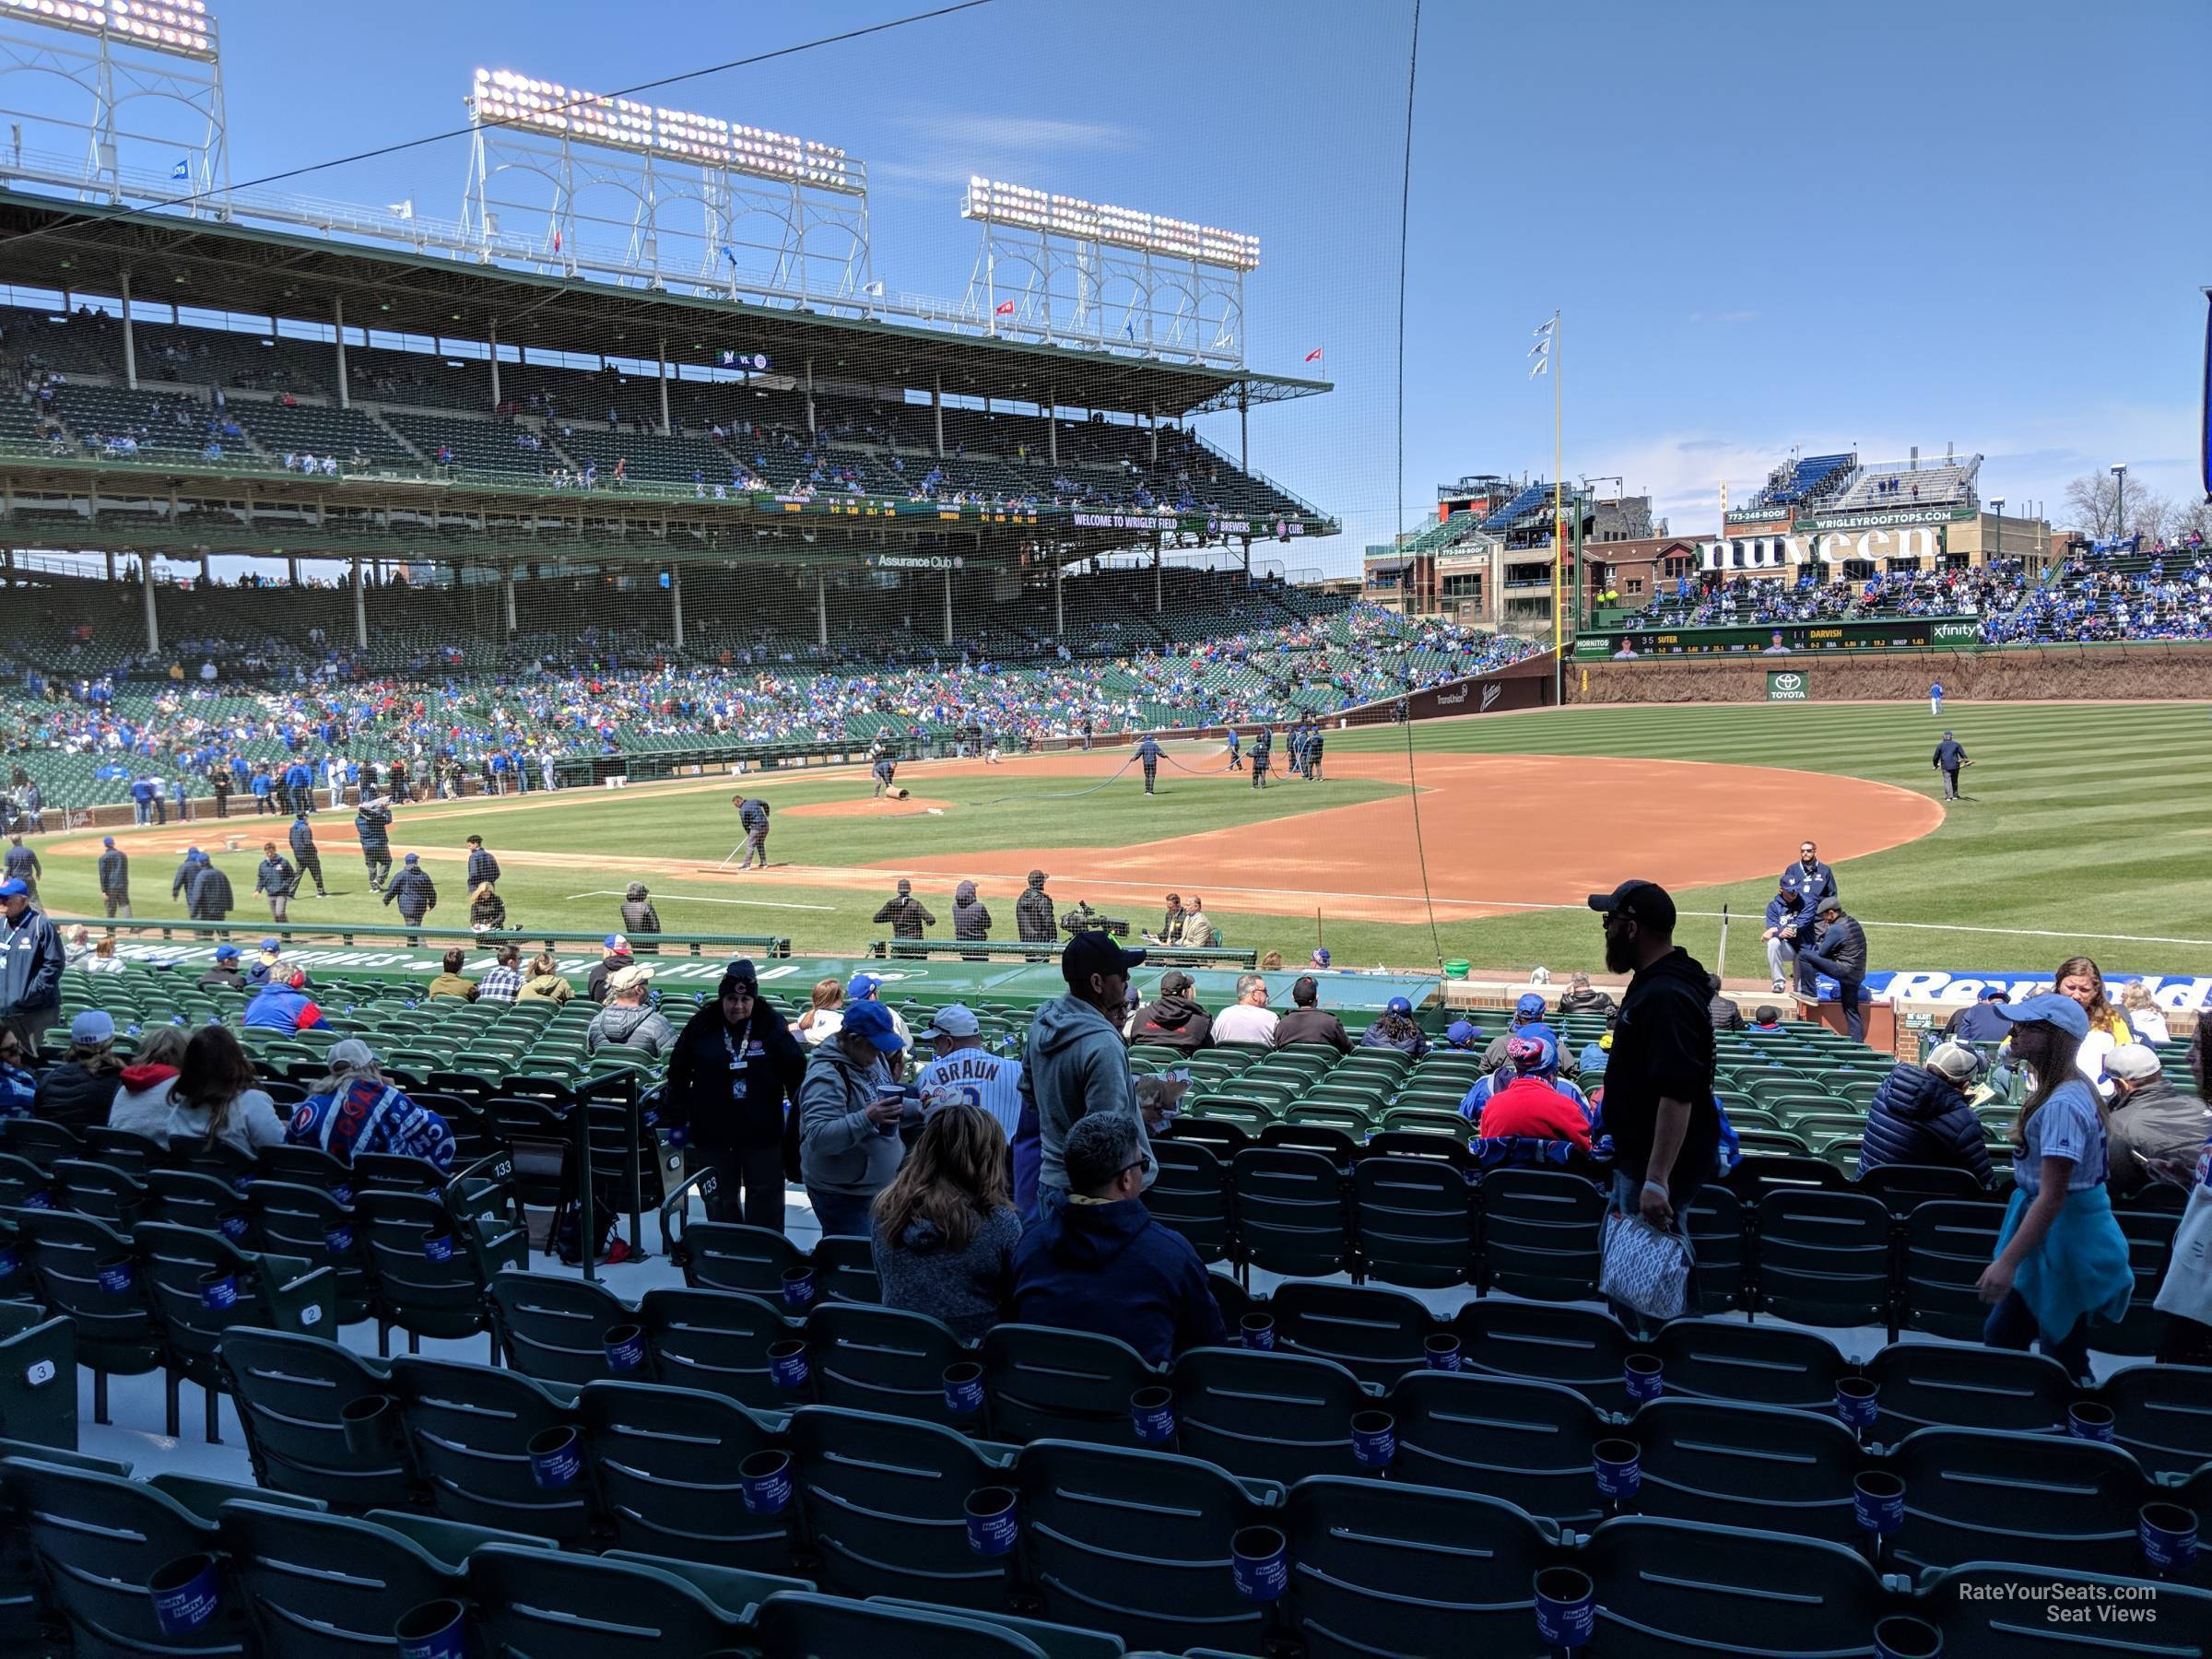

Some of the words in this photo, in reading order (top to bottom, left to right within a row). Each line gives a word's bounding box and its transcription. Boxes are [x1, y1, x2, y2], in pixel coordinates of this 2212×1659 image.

[785, 503, 801, 512] SUTER
[1074, 513, 1112, 526] WELCOME
[1113, 515, 1124, 526] TO
[1125, 516, 1156, 528] WRIGLEY
[1159, 517, 1178, 530] FIELD
[1728, 510, 1786, 521] 773-248-ROOF
[1816, 512, 1951, 529] WRIGLEYROOFTOPS.COM
[1220, 521, 1250, 533] BREWERS
[1288, 522, 1305, 535] CUBS
[1699, 525, 1936, 571] nuveen
[878, 554, 930, 567] Assurance
[931, 556, 952, 569] Club
[1810, 629, 1842, 638] DARVISH
[1935, 624, 1976, 638] xfinity
[1577, 639, 1610, 647] HORNITOS
[1657, 636, 1677, 644] SUTER
[1437, 694, 1464, 705] TransUnion
[936, 1059, 1000, 1085] BRAUN
[494, 1160, 512, 1178] 133
[702, 1176, 717, 1195] 133
[309, 1309, 316, 1321] 2
[38, 1366, 46, 1379] 3
